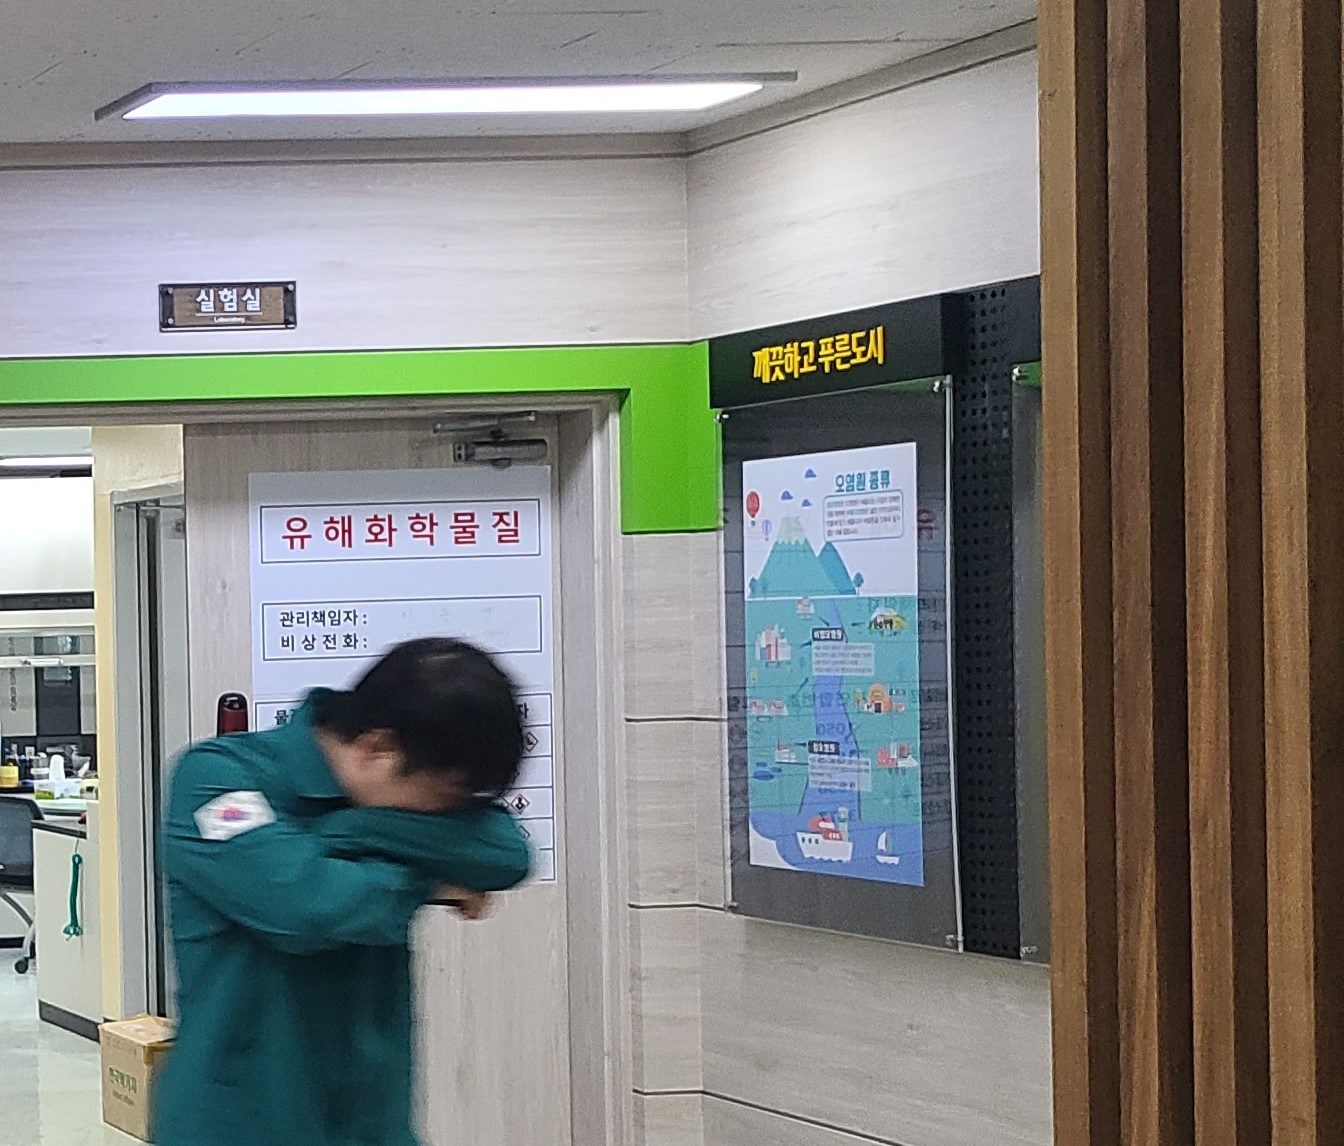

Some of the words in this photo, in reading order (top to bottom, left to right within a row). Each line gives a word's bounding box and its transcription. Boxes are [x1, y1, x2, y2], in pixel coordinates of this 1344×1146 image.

[196, 288, 261, 312] 실험실
[752, 341, 817, 383] 깨끗하고
[818, 325, 883, 373] 푸른도시
[835, 472, 866, 492] 오염원
[281, 510, 521, 550] 유해화학물질
